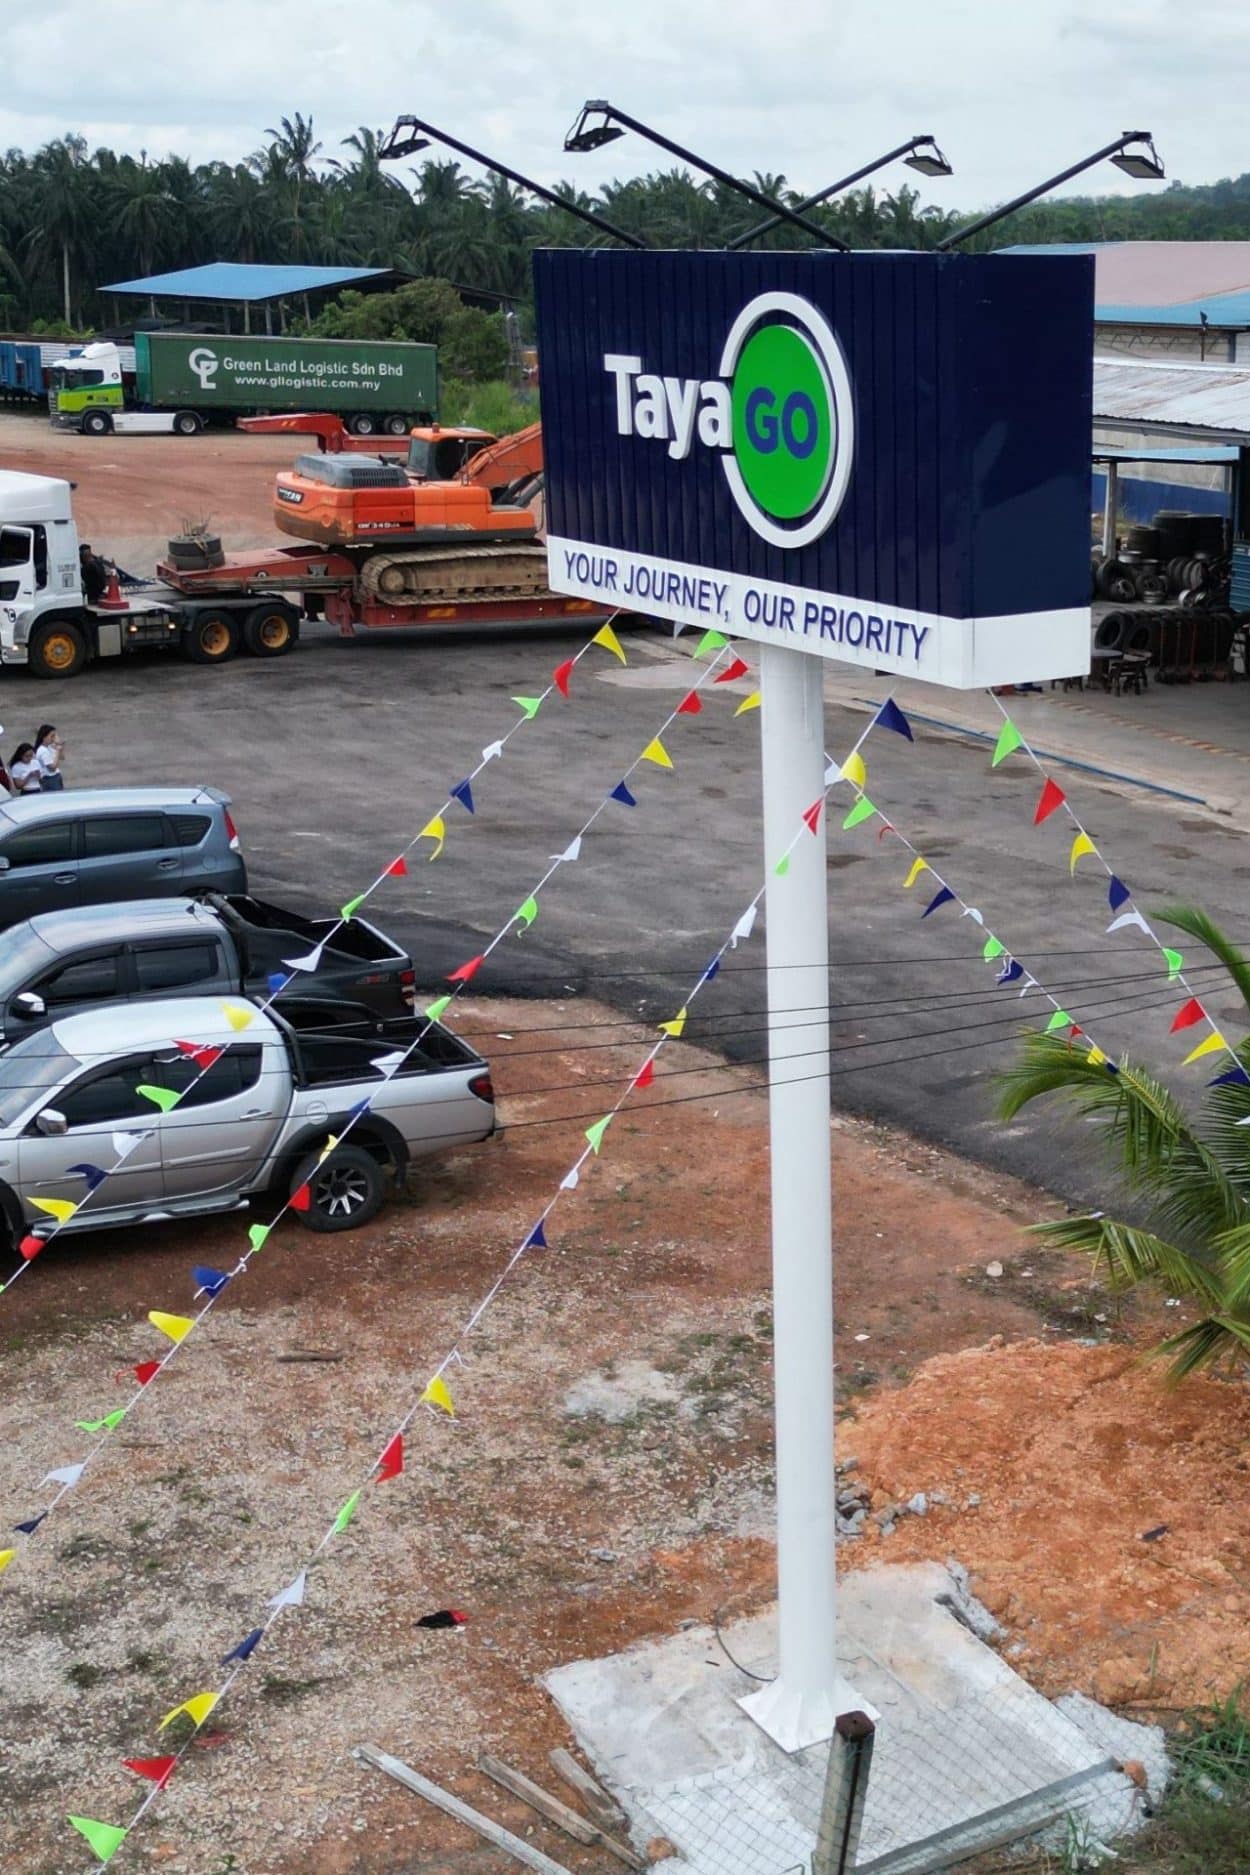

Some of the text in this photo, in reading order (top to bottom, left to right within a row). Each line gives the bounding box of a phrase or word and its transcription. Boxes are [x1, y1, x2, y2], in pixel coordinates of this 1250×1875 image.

[223, 356, 404, 377] Green Land Logistic Sdn Bhd
[234, 375, 381, 392] www.gllogistic.com.my
[564, 549, 930, 661] YOUR JOURNEY, OUR PRIORITY
